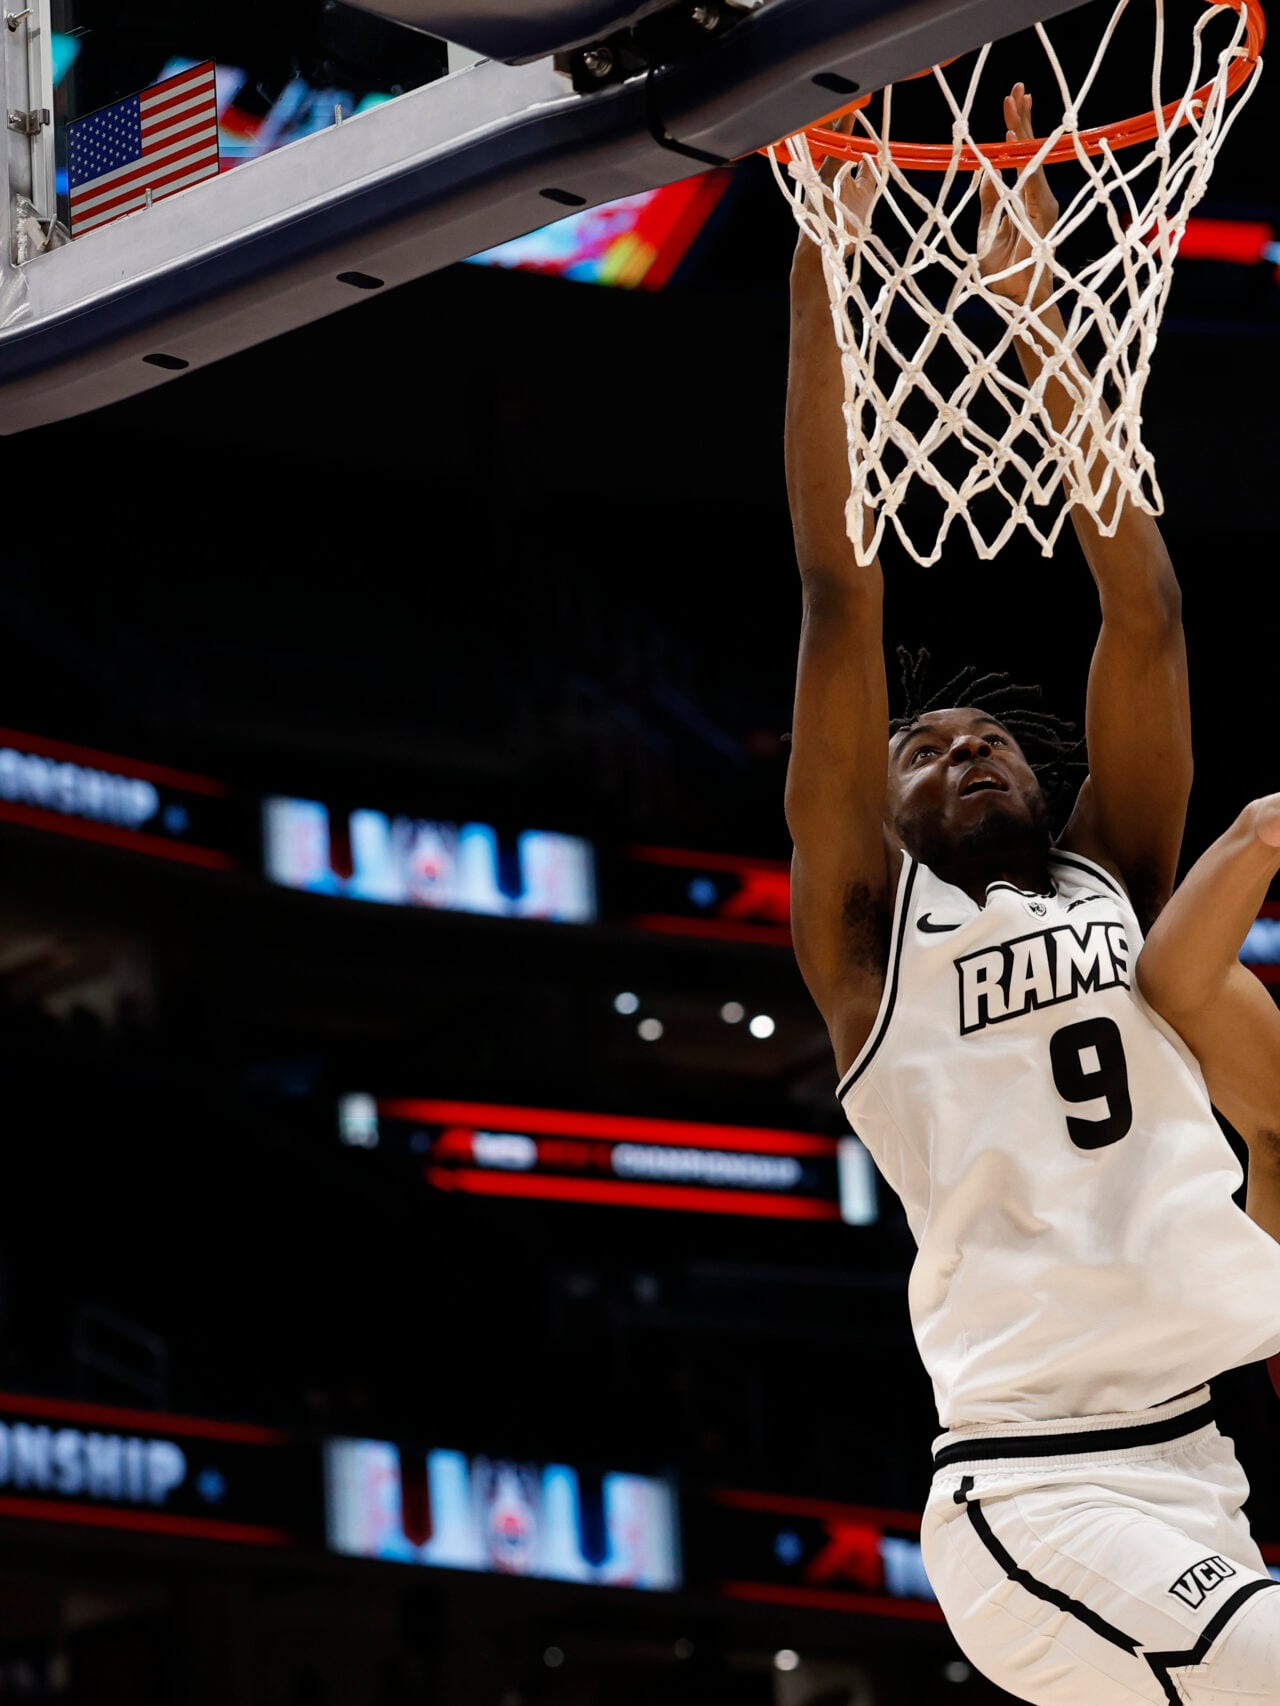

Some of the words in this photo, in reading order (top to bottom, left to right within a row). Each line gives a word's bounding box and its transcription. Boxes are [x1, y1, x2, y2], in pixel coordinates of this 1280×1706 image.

[953, 921, 1131, 1036] RAMS
[1049, 1016, 1133, 1150] 9
[1168, 1555, 1237, 1610] VCU
